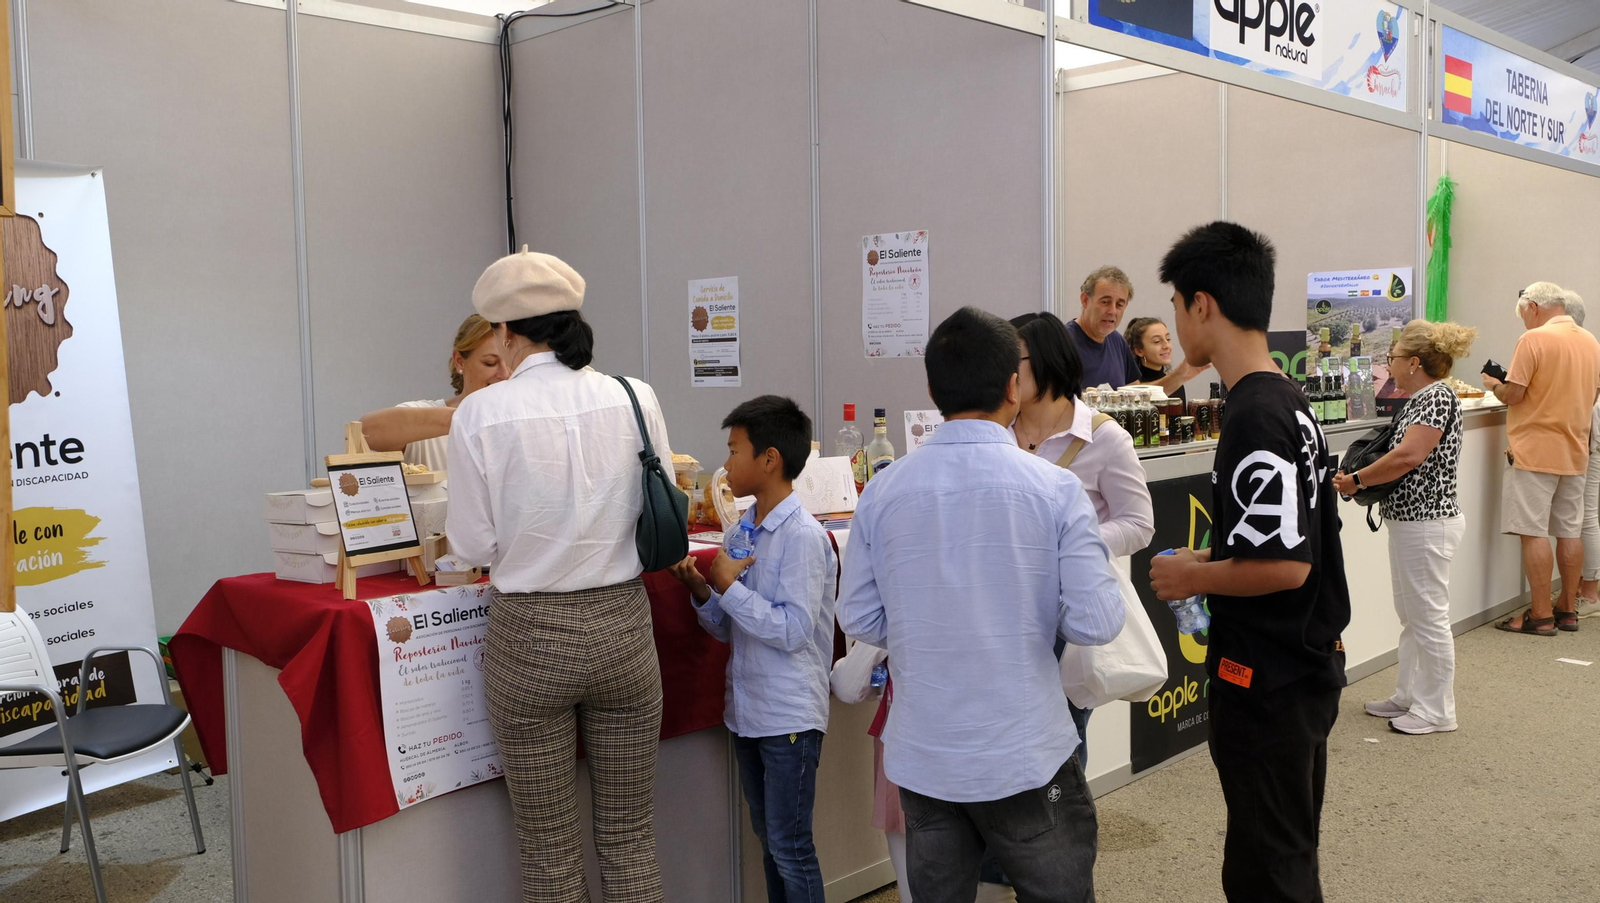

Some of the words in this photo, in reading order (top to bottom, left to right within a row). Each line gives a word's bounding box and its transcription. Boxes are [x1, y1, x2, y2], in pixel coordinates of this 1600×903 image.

[1213, 0, 1317, 52] apple
[1274, 43, 1309, 65] natural
[1506, 68, 1549, 106] TABERNA
[1485, 98, 1504, 127] DEL
[1506, 105, 1537, 136] NORTE
[1539, 115, 1546, 139] Y
[1547, 118, 1565, 144] SUR
[880, 250, 887, 260] El
[888, 248, 922, 259] Saliente
[925, 424, 932, 432] El
[16, 471, 89, 487] DISCAPACIDAD
[359, 478, 366, 486] El
[367, 476, 394, 485] Saliente
[34, 523, 64, 541] con
[43, 600, 94, 617] sociales
[413, 614, 428, 630] El
[431, 605, 490, 627] Saliente
[47, 628, 96, 646] sociales
[393, 645, 448, 663] Repostería
[89, 667, 106, 681] de
[398, 664, 409, 677] El
[430, 654, 468, 669] tradicional
[1221, 659, 1246, 678] PRESENT
[1148, 675, 1198, 723] apple
[1177, 717, 1195, 732] MARCA
[1195, 713, 1202, 725] DE
[408, 742, 422, 751] HAZ
[423, 740, 432, 748] TU
[432, 731, 465, 745] PEDIDO:
